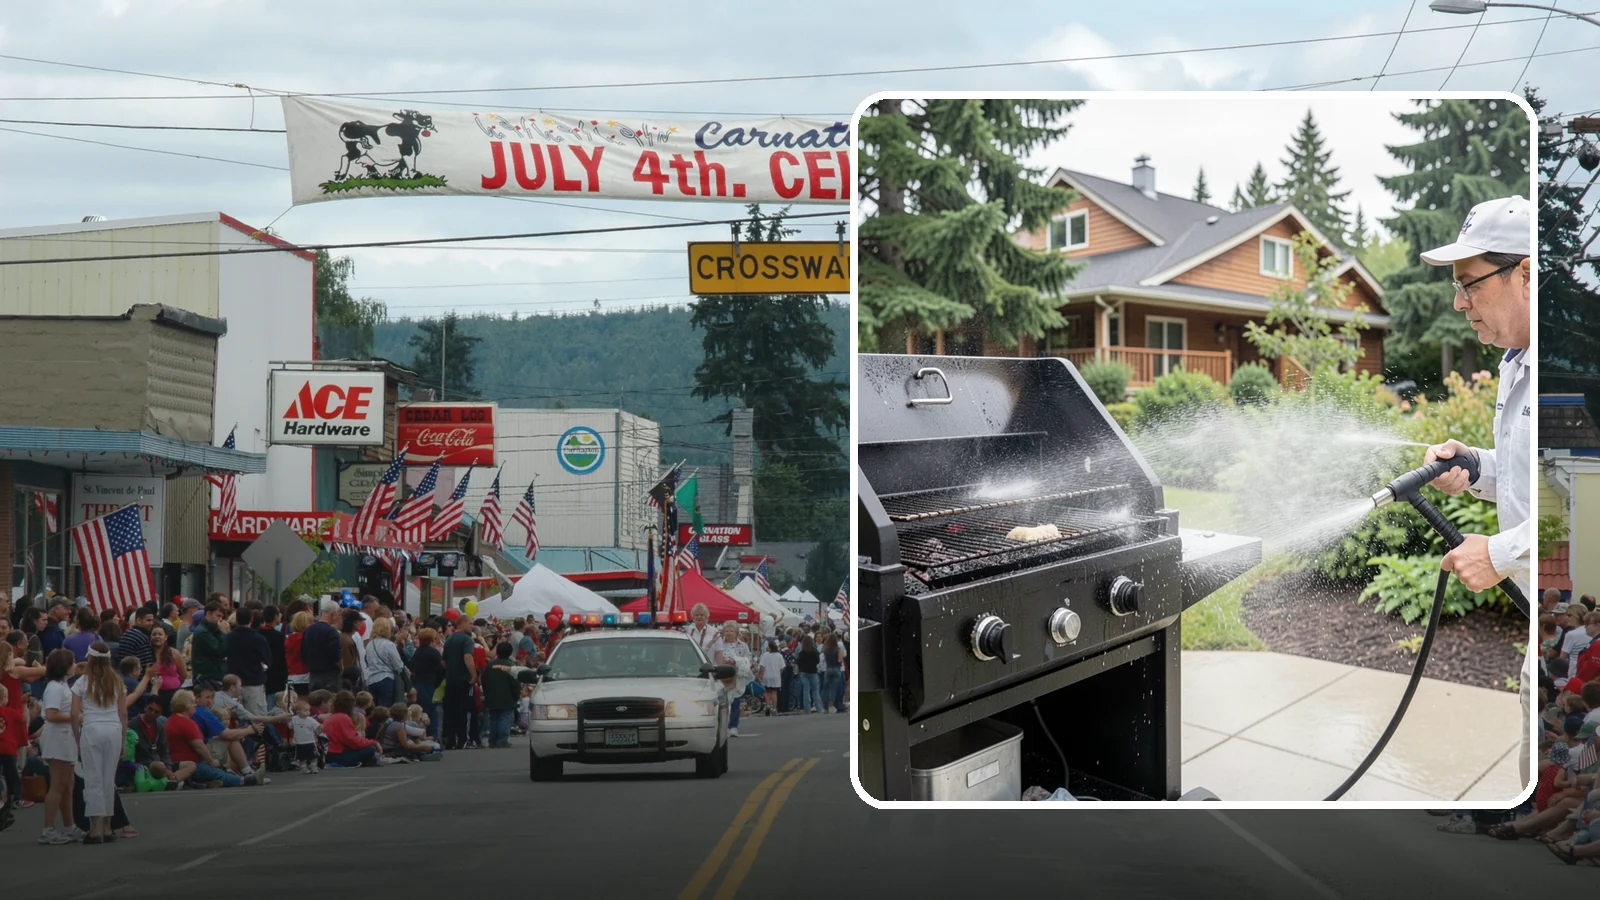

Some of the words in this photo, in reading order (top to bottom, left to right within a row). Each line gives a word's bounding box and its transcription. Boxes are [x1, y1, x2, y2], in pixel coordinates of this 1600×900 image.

[481, 141, 605, 193] JULY
[632, 150, 746, 198] 4th.
[697, 254, 850, 280] CROSSWA
[283, 380, 373, 420] ACE
[406, 410, 452, 422] CEDAR
[461, 410, 485, 422] LOG
[283, 421, 370, 436] Hardware
[95, 484, 124, 495] Vincent
[126, 486, 136, 495] de
[137, 486, 155, 495] Paul
[688, 526, 742, 535] CRNATION
[699, 535, 730, 543] GLASS
